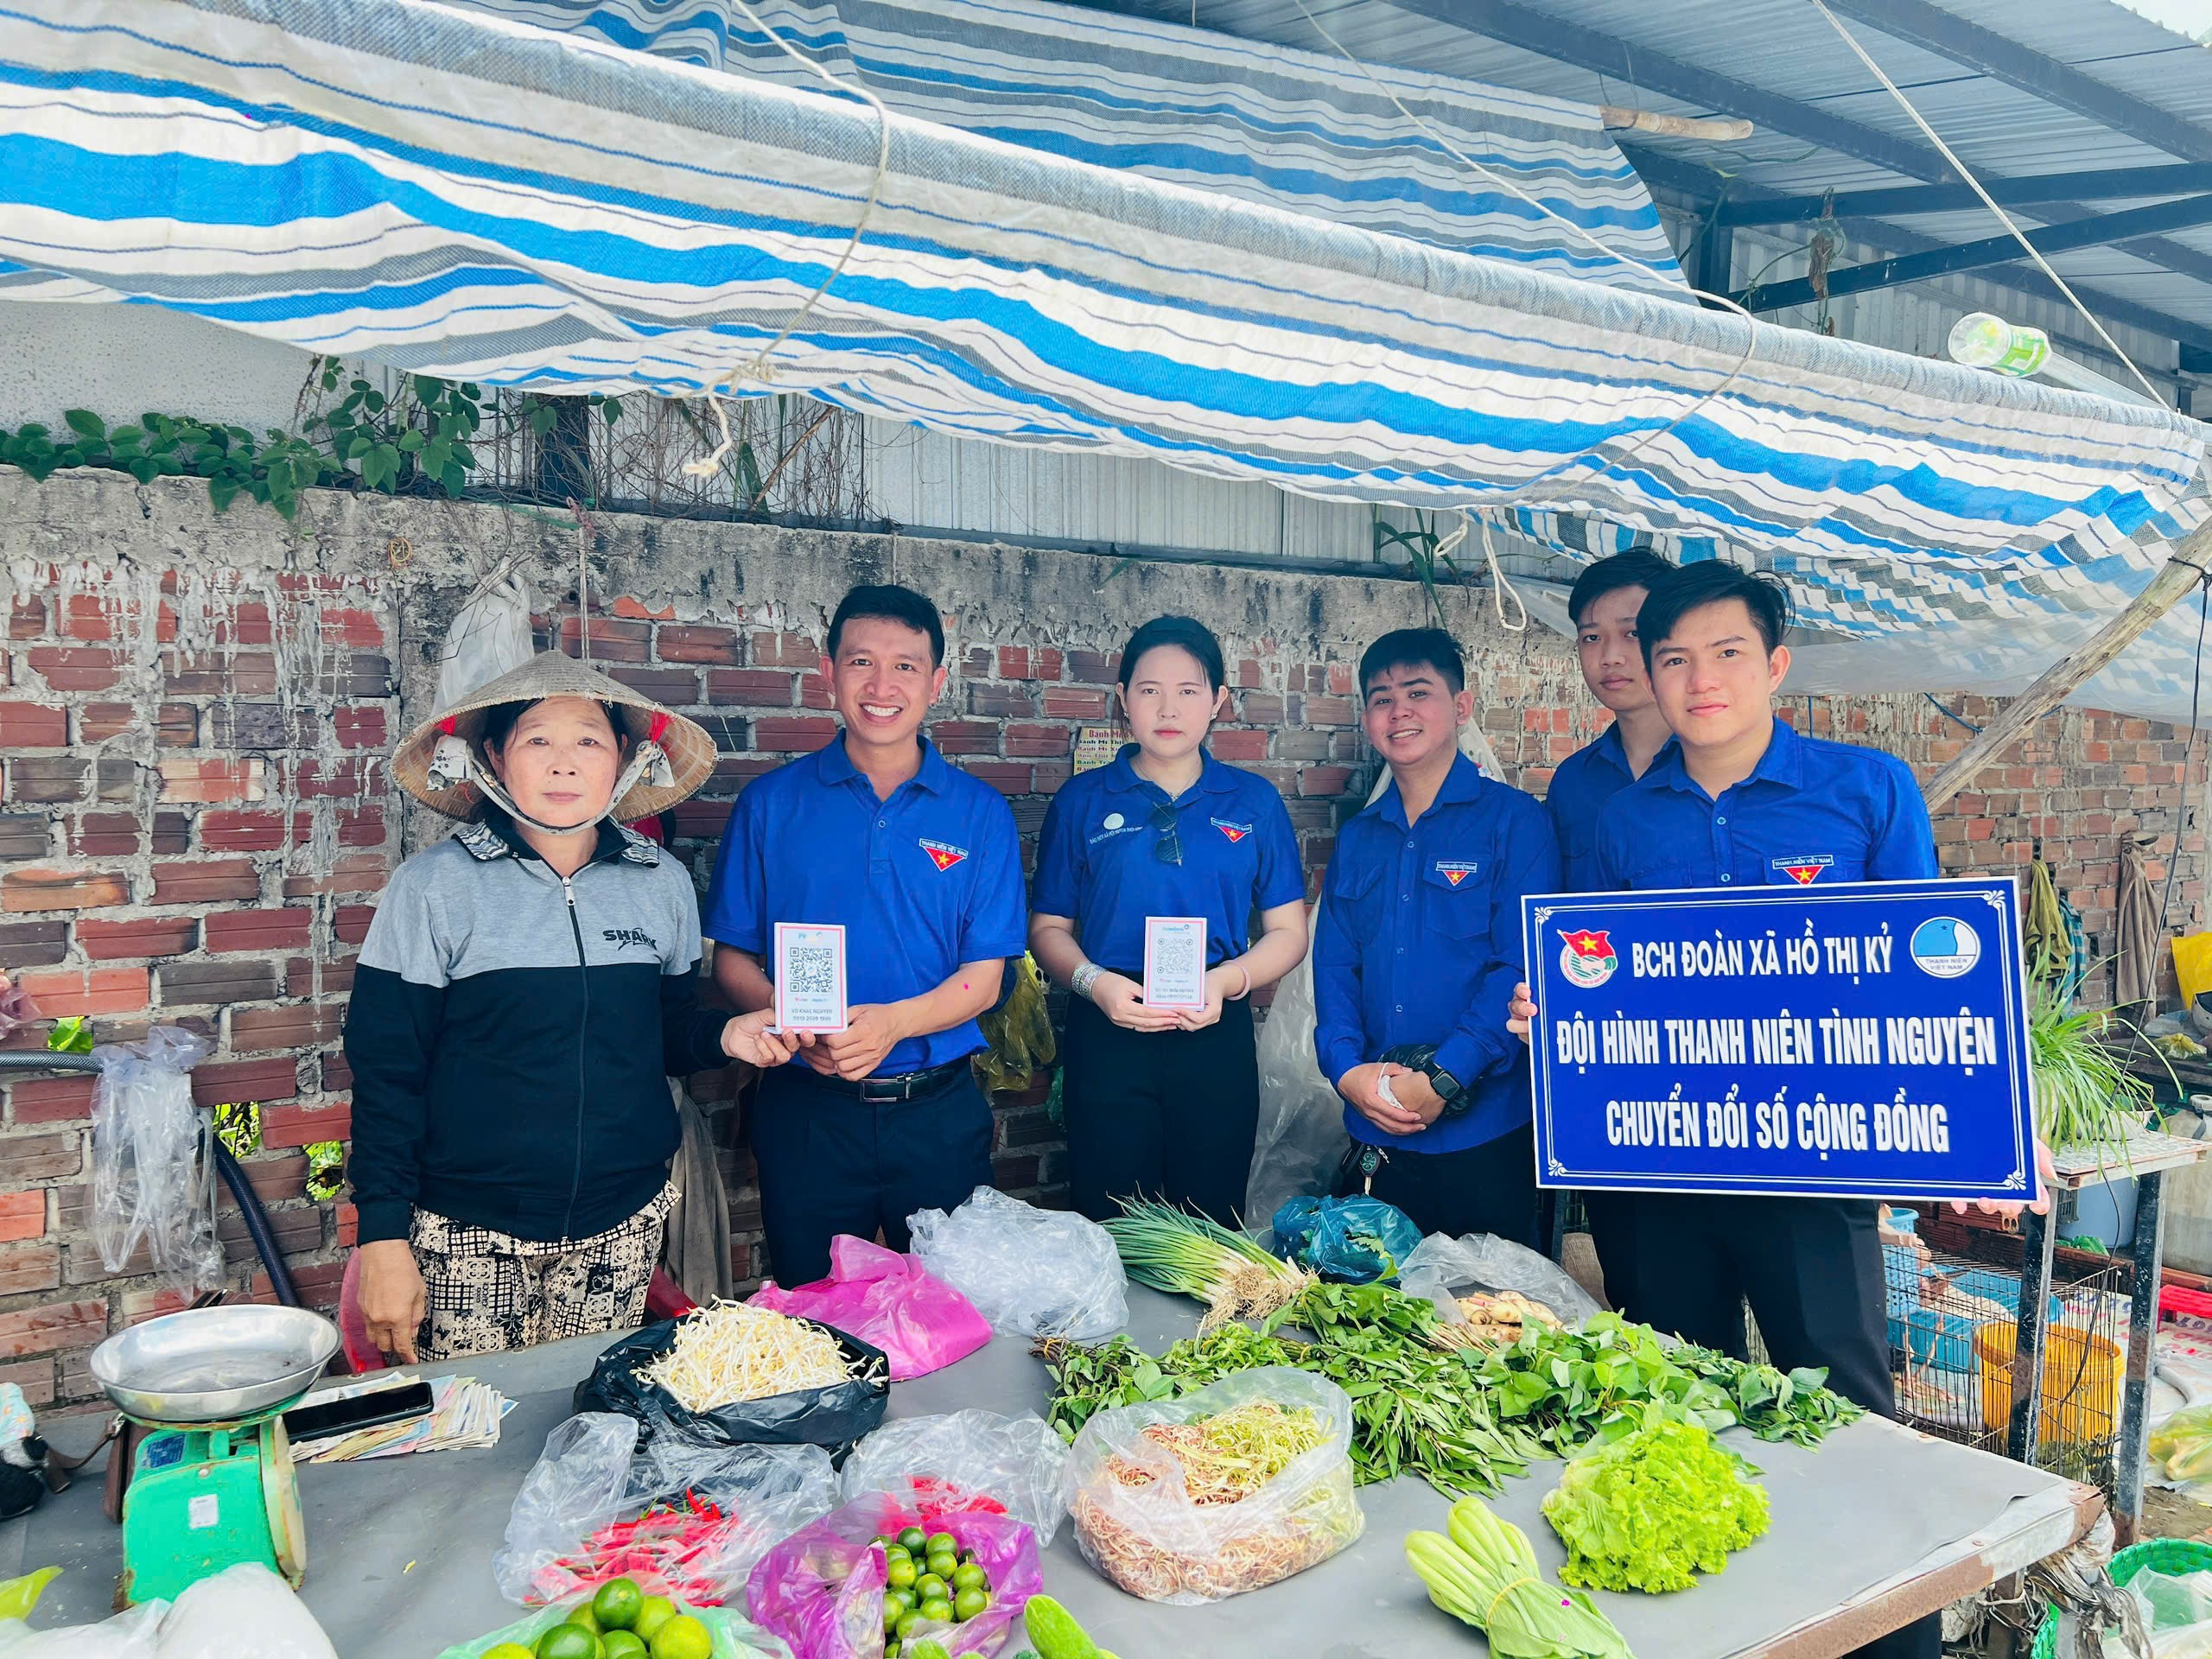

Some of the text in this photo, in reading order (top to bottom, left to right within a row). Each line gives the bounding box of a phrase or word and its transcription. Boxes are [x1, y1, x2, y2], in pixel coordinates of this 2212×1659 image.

[602, 929, 658, 950] SHARK
[1631, 942, 1676, 978] BCH
[1681, 929, 1744, 977] ĐOÀN
[1749, 930, 1782, 976] XÃ
[1785, 918, 1820, 975] HỒ
[1823, 937, 1859, 985] THỊ
[1865, 921, 1893, 973] KỶ
[1556, 1007, 1997, 1076] ĐỘI HÌNH THANH NIÊN TÌNH NGUYỆN
[1606, 1083, 1950, 1160] CHUYỂN ĐỔI SỐ CỘNG ĐỒNG
